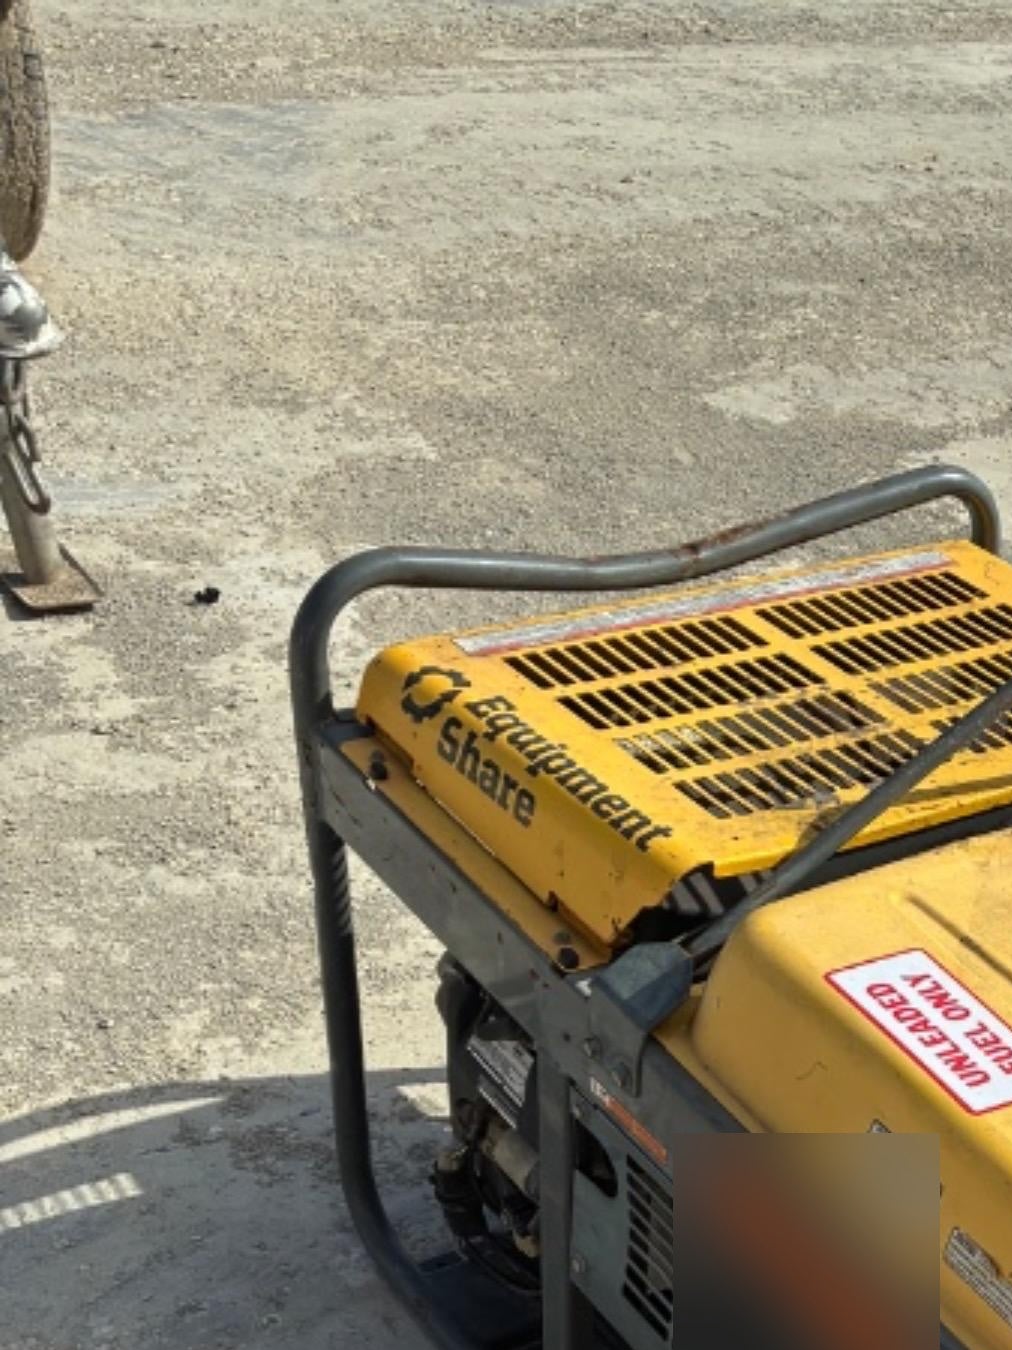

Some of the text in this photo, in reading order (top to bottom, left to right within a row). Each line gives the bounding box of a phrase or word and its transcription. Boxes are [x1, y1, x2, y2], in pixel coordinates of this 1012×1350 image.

[437, 716, 535, 828] Share
[464, 695, 673, 853] Equipment
[866, 982, 991, 1088] UNLEADED
[900, 973, 970, 1022] ONLY
